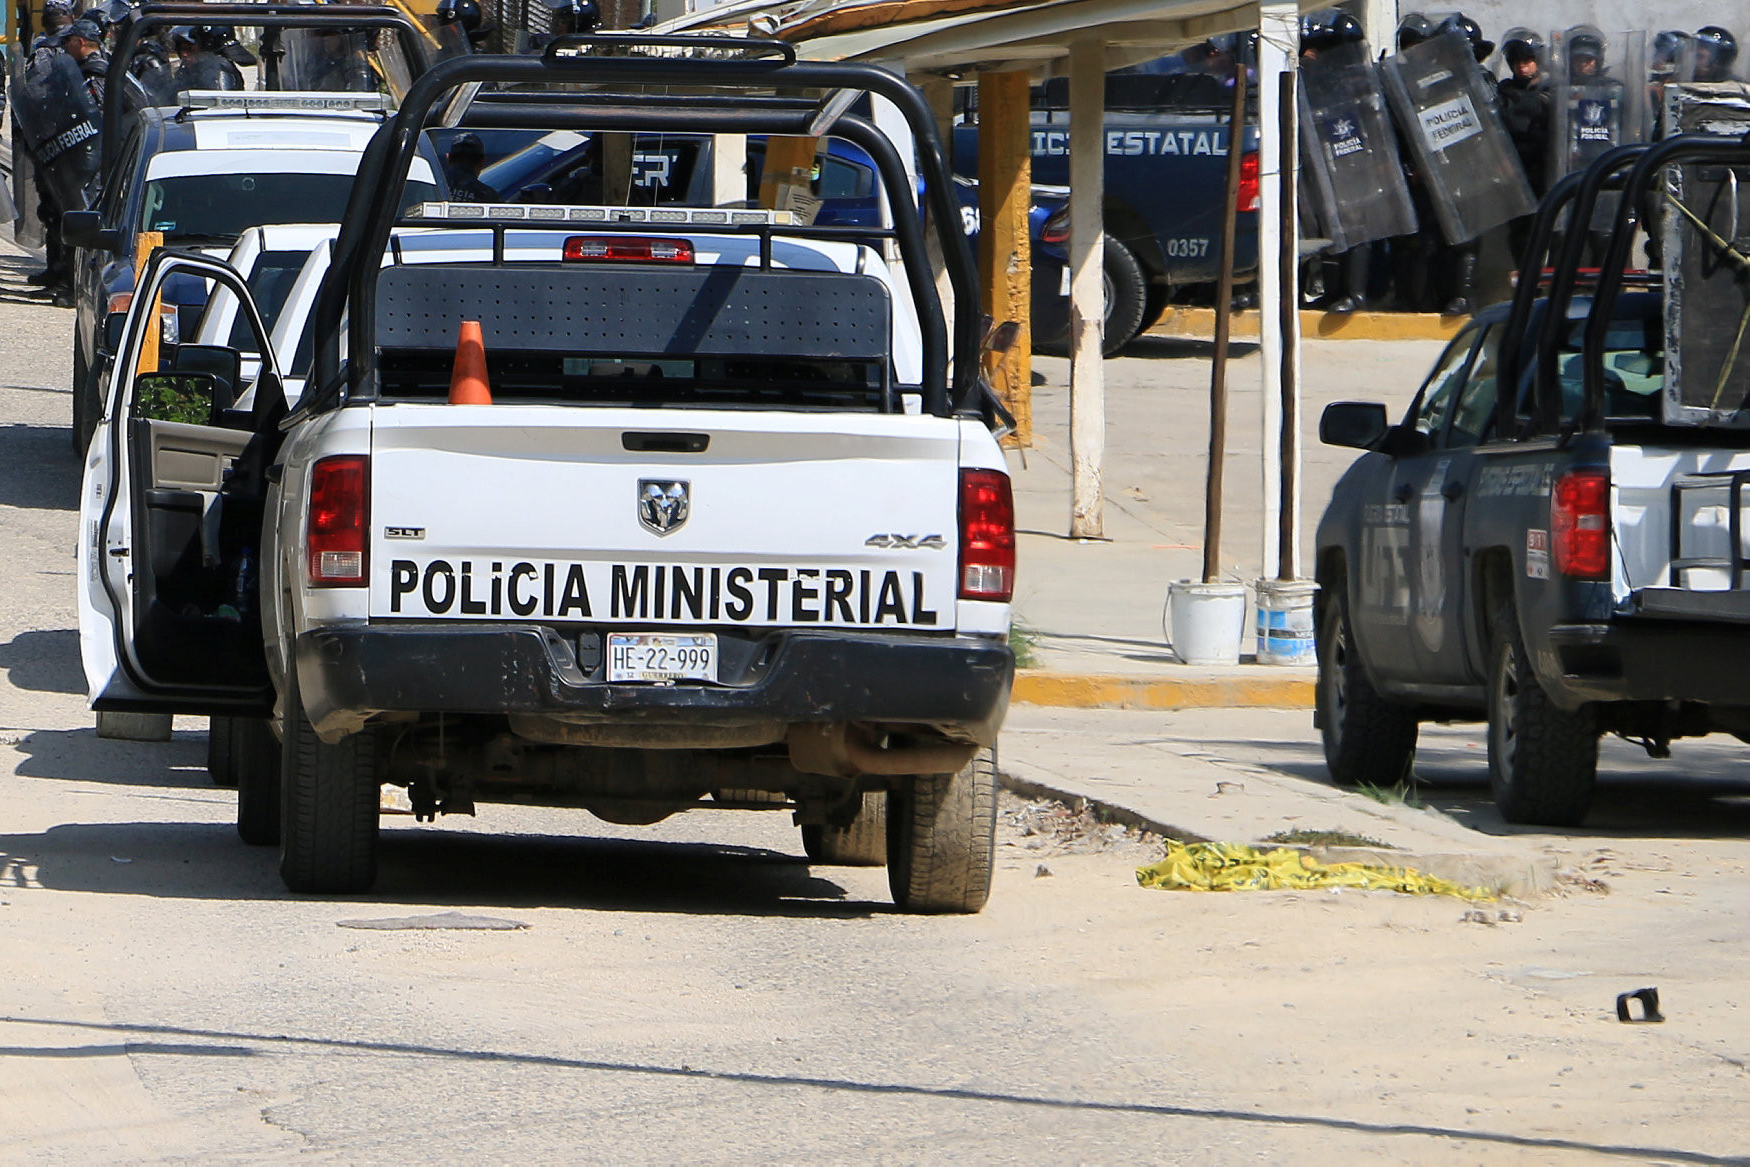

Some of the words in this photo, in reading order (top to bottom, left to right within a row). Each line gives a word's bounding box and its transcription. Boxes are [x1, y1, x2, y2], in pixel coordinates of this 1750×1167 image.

[57, 119, 99, 151] FEDERAL
[1107, 132, 1229, 156] ESTATAL
[1167, 238, 1210, 257] 0357
[387, 528, 419, 537] SLT
[611, 564, 938, 625] MINISTERIAL
[613, 647, 710, 670] HE-22-999
